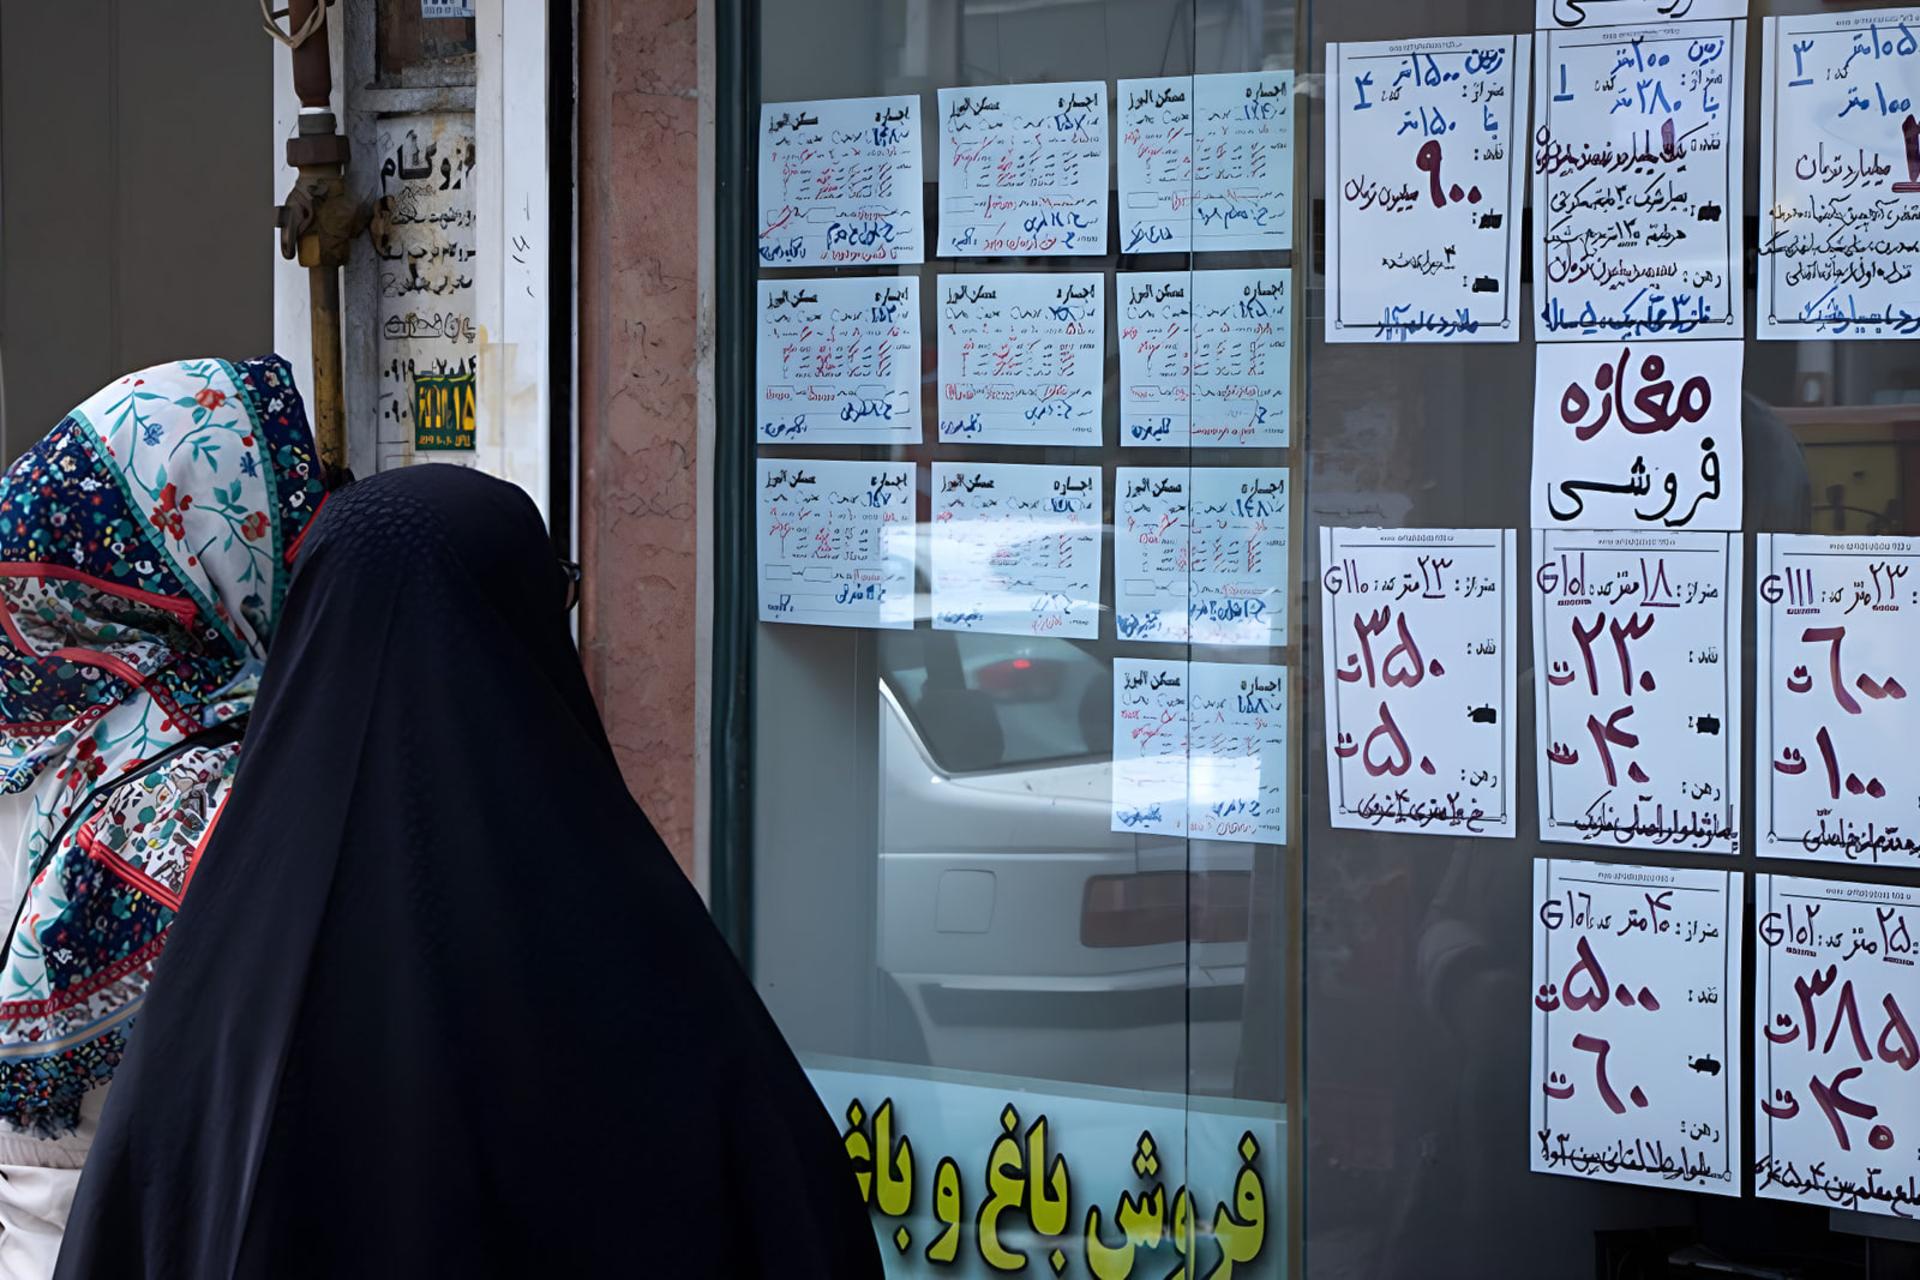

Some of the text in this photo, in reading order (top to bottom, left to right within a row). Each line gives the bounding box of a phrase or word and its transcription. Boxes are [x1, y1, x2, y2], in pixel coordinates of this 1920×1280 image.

[1560, 347, 1712, 441] مغازه
[1547, 437, 1720, 527] فروشی
[1395, 573, 1420, 600] متر
[1353, 605, 1446, 688] ۳۵۰
[1362, 701, 1437, 777] ۵۰
[1586, 705, 1651, 788] ۴۰
[1815, 725, 1887, 800] ۱۰۰
[1616, 908, 1648, 937] متر
[1842, 927, 1878, 961] متر
[1876, 907, 1912, 956] ۲۵
[1562, 935, 1660, 1012] ۵۰۰
[1809, 1067, 1896, 1151] ۴۰
[925, 1155, 964, 1263] و
[976, 1102, 1071, 1277] باغ
[1086, 1130, 1267, 1280] فروش
